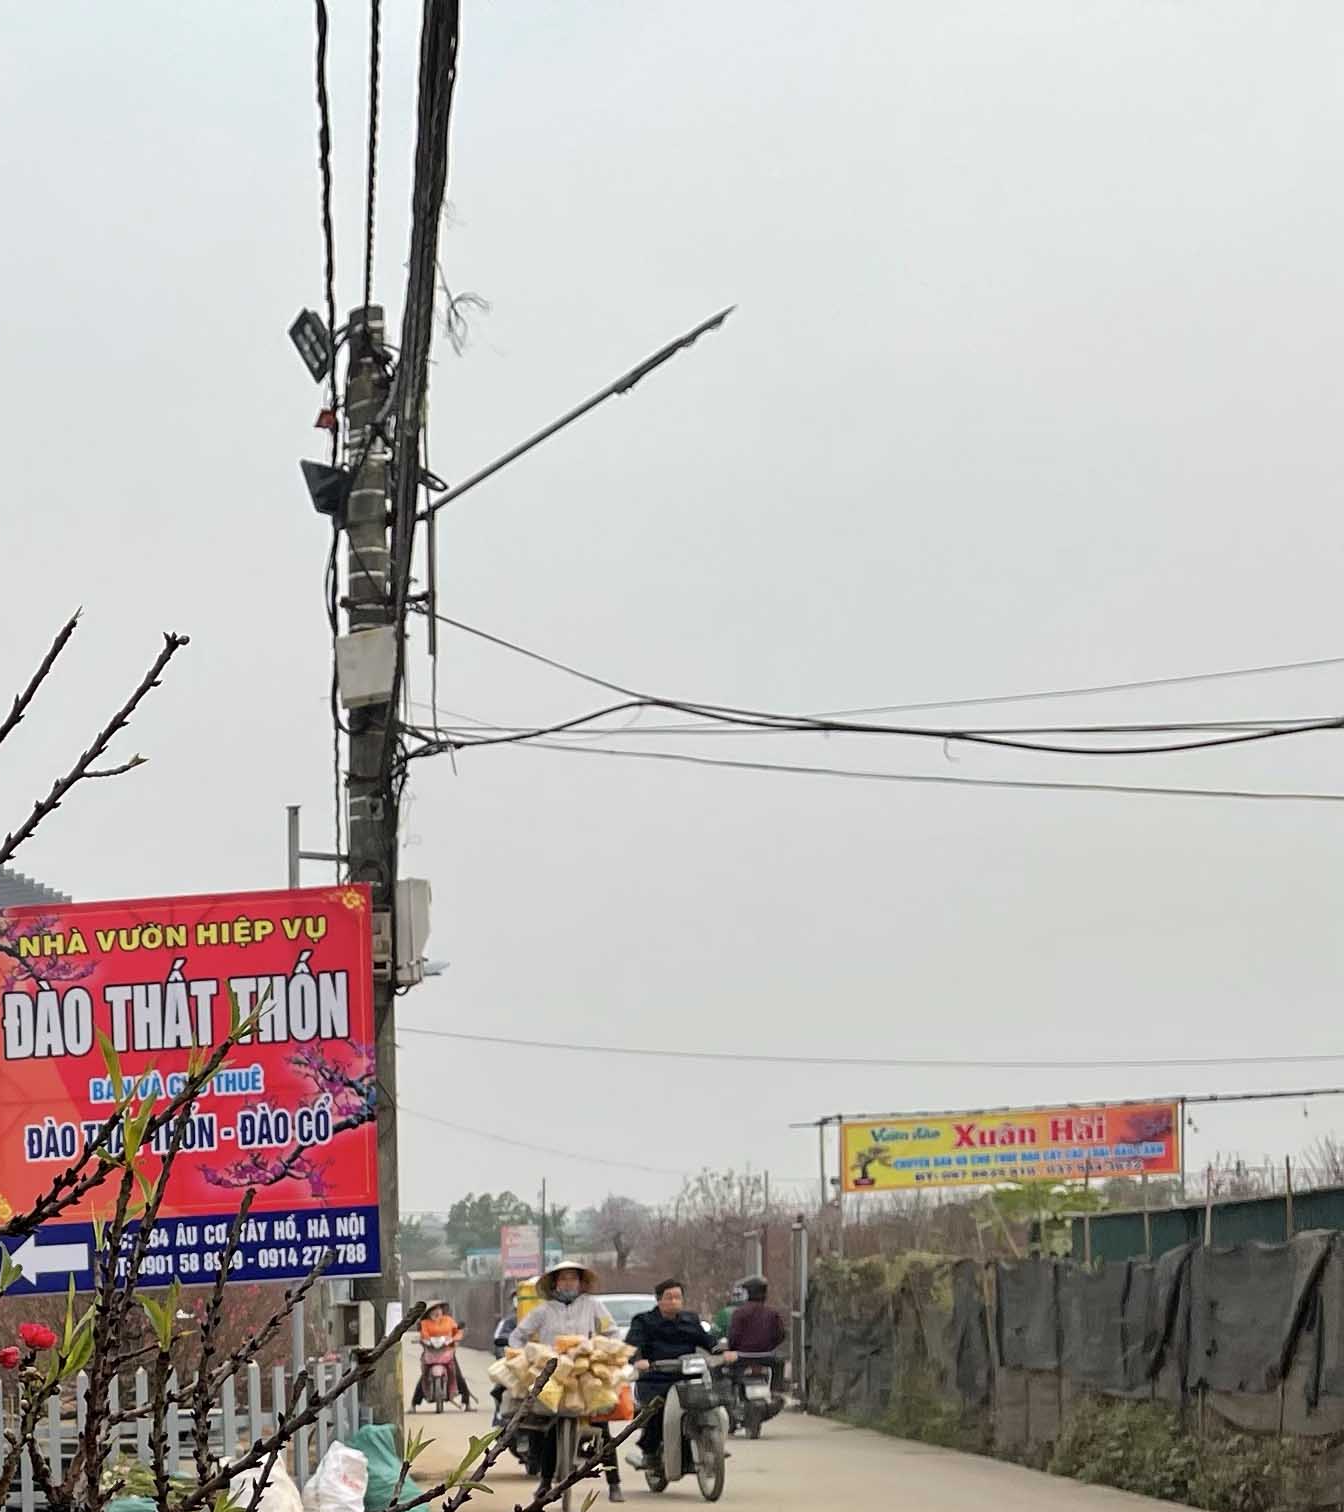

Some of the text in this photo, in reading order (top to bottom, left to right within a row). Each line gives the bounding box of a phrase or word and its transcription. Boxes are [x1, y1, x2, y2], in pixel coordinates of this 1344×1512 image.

[19, 915, 328, 957] NHÀ VƯỜN HIỆP VỤ
[3, 950, 349, 1060] ĐÀO THẤT THỐN
[215, 1066, 262, 1094] THUÊ
[27, 1119, 76, 1159] ĐÀO
[240, 1106, 289, 1146] ĐÀO
[298, 1096, 330, 1143] CỔ
[175, 1223, 198, 1246] ÂU
[274, 1213, 301, 1242] HỒ,
[307, 1214, 330, 1239] HÀ
[336, 1212, 365, 1240] NỘI
[179, 1253, 200, 1273] 58
[258, 1247, 298, 1269] 0914
[335, 1243, 367, 1265] 788
